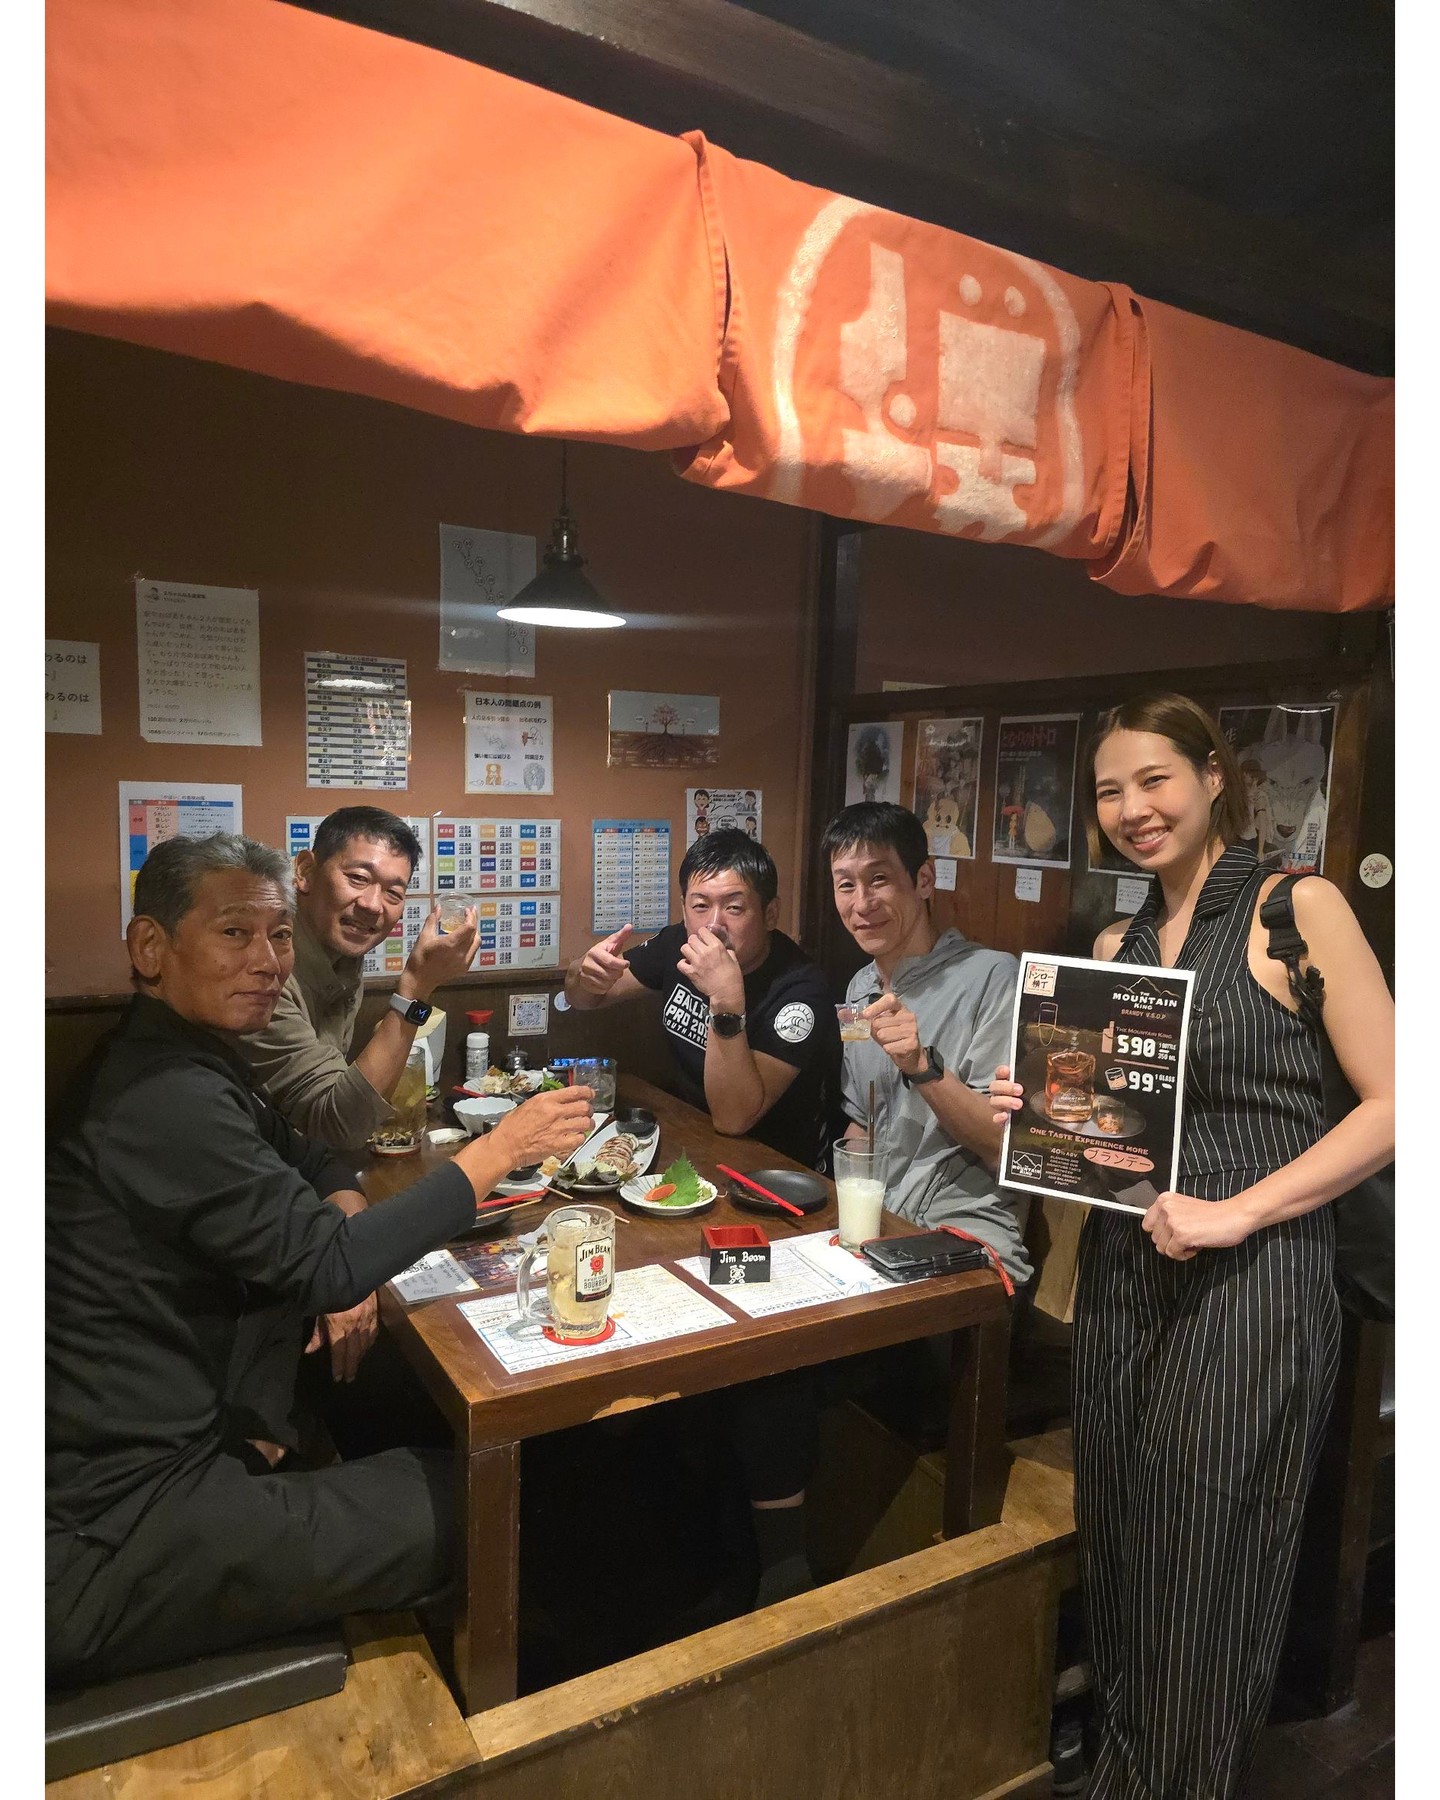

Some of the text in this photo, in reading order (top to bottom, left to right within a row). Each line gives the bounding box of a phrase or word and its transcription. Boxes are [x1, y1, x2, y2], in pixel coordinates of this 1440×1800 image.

[475, 698, 542, 709] 日本人の問題点の例
[1028, 970, 1054, 980] トンロー
[1032, 980, 1049, 989] 横丁
[1112, 992, 1178, 1008] MOUNTAIN
[1133, 1002, 1153, 1010] KING
[666, 1004, 691, 1027] PRO
[1128, 1028, 1157, 1037] MOUNTAIN
[1117, 1034, 1156, 1058] 590
[1029, 1126, 1149, 1155] ONE TASTE EXPERIENCE MORE
[580, 1247, 593, 1262] JIM
[720, 1250, 766, 1264] Jim Beam
